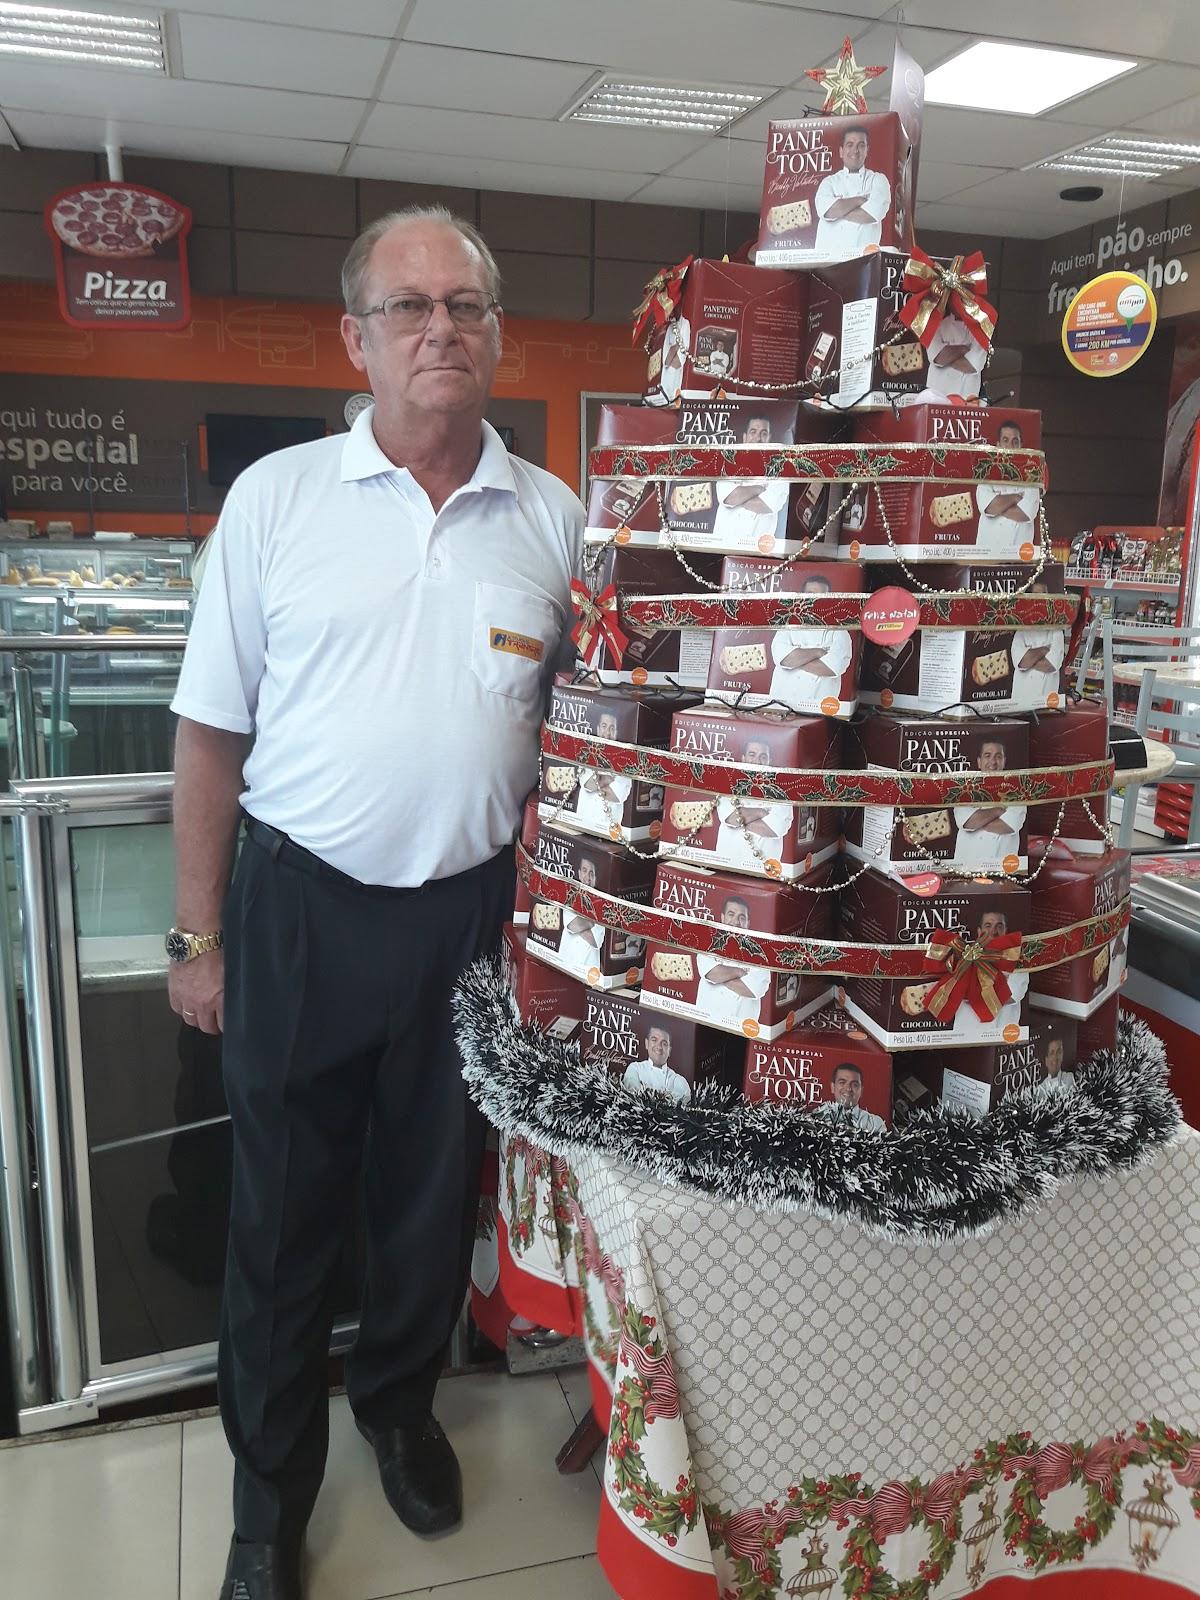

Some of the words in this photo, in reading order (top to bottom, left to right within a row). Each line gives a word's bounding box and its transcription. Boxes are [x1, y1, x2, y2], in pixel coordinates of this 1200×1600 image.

[772, 130, 825, 152] PANE
[775, 151, 833, 175] TONE
[774, 239, 802, 247] FRUTAS
[1051, 260, 1073, 275] Aqui
[1075, 252, 1095, 268] tem
[1097, 221, 1145, 269] pão
[1146, 223, 1192, 247] sempre
[84, 270, 167, 300] Pizza
[703, 305, 739, 315] PANETONE
[682, 402, 706, 410] EDIÇÃO
[930, 408, 956, 416] EDIÇÃO
[958, 409, 990, 417] ESPECIAL
[0, 408, 37, 432] qui
[46, 408, 103, 430] tudo
[111, 409, 126, 431] é
[682, 411, 730, 433] PANE
[932, 418, 984, 440] PANE
[12, 474, 63, 496] para
[71, 471, 134, 494] você.
[669, 520, 709, 530] CHOCOLATE
[934, 533, 961, 541] FRUTAS
[922, 547, 934, 556] Peso
[943, 547, 952, 557] 400
[757, 563, 794, 572] ESPEIAL
[728, 570, 783, 593] PANE
[975, 579, 1017, 594] PANE
[864, 611, 886, 620] Feliz
[889, 609, 917, 619] Natal
[972, 690, 1008, 699] CHOCOLATE
[552, 699, 588, 723] PANE
[674, 719, 700, 727] EDIÇÃO
[703, 723, 737, 732] ESPECIAL
[675, 727, 727, 753] PANE
[906, 738, 961, 760] PANE
[677, 835, 703, 846] FRTAS
[537, 838, 570, 866] PANE
[903, 849, 950, 858] CHOLATE
[541, 858, 575, 879] TONE
[658, 871, 682, 881] EDIÇÃO
[684, 878, 716, 890] ESPECIAL
[659, 879, 707, 910] PANE
[904, 907, 961, 930] PANE
[531, 932, 557, 948] CHOCOLATE
[658, 985, 684, 998] FRUTAS
[587, 995, 609, 1006] EDIÇÃO
[611, 1003, 641, 1016] ESPECIAL
[587, 1003, 632, 1034] PANE
[901, 1020, 948, 1029] CHOCOLATE
[591, 1026, 641, 1059] TONE
[893, 1035, 905, 1044] Peso
[916, 1035, 926, 1043] 400
[753, 1045, 782, 1054] EDIÇÃO
[785, 1048, 824, 1058] ESPECIAL
[1000, 1044, 1035, 1075] PANE
[755, 1054, 814, 1080] PANE
[1001, 1063, 1041, 1094] TONE
[760, 1076, 823, 1104] TONE
